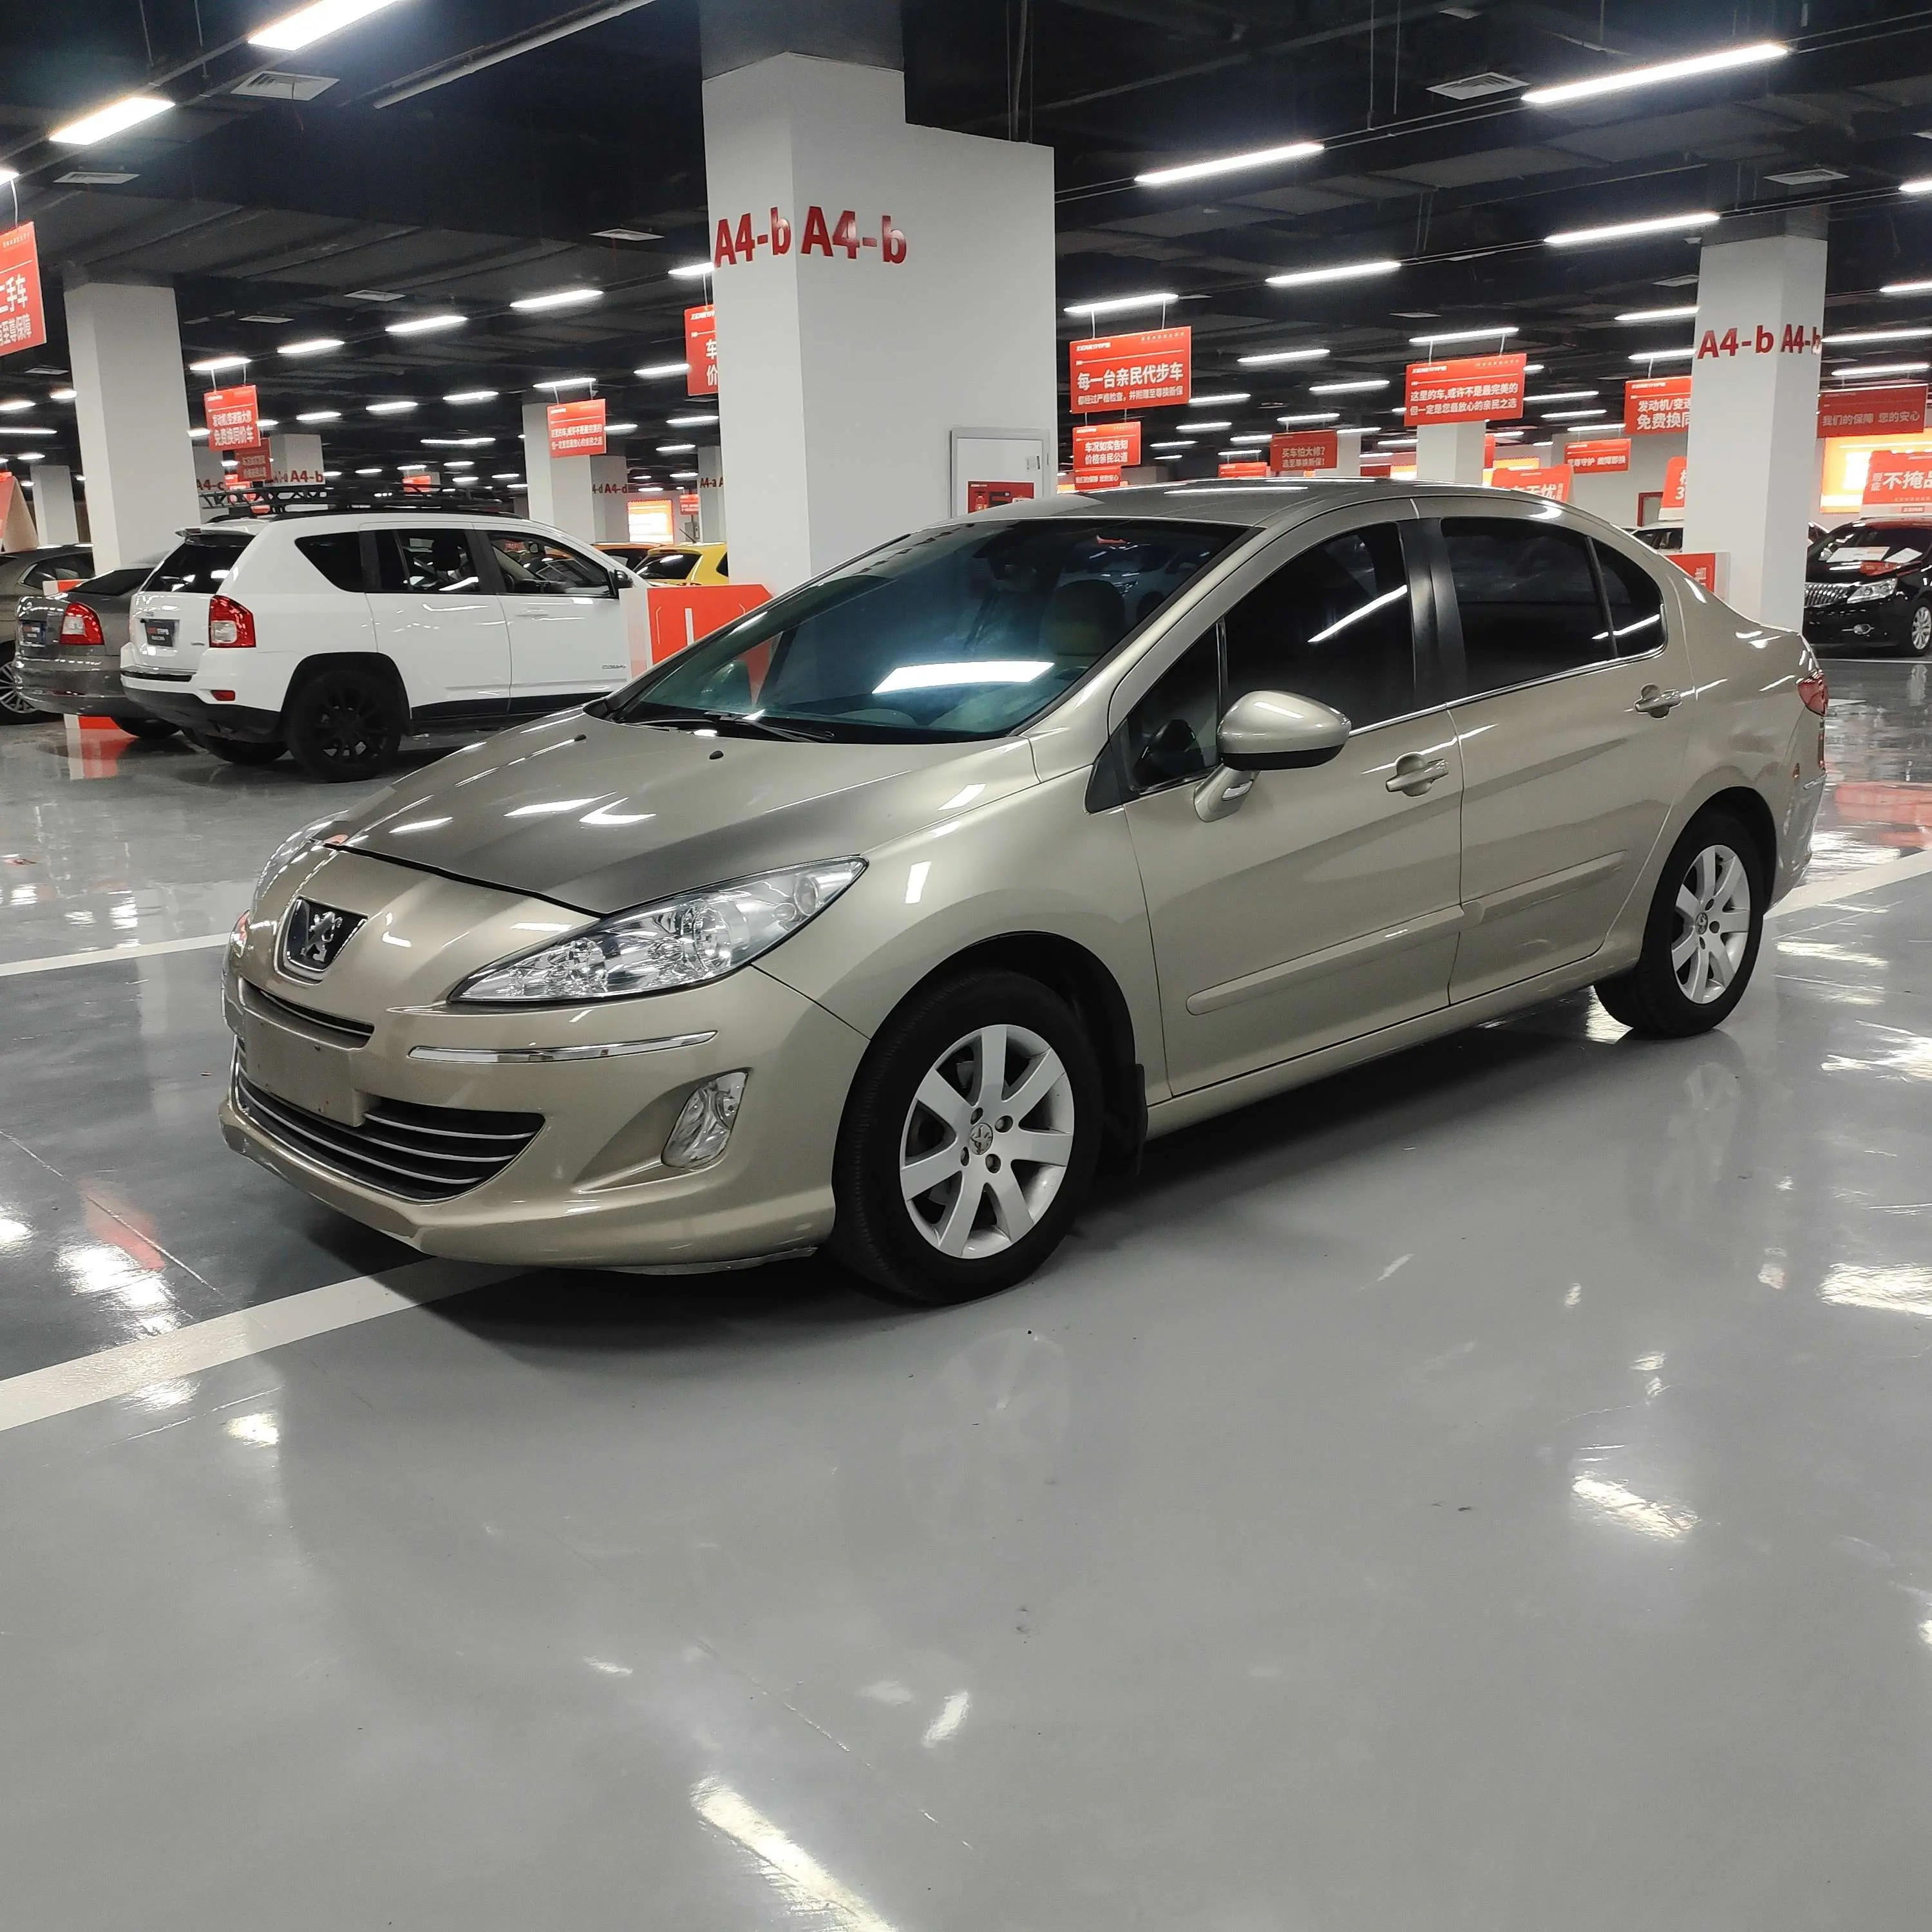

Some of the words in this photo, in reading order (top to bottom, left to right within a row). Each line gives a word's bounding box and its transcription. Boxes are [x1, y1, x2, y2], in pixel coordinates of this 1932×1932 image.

[714, 206, 791, 268] A4-b
[800, 205, 907, 264] A4-b
[1697, 325, 1774, 359] A4-b
[1780, 324, 1822, 354] A4-b
[1077, 361, 1184, 391] 每一台亲民代步车
[1822, 412, 1873, 426] 我们的保障
[1877, 410, 1920, 423] 您的安心
[290, 470, 324, 482] A4-b
